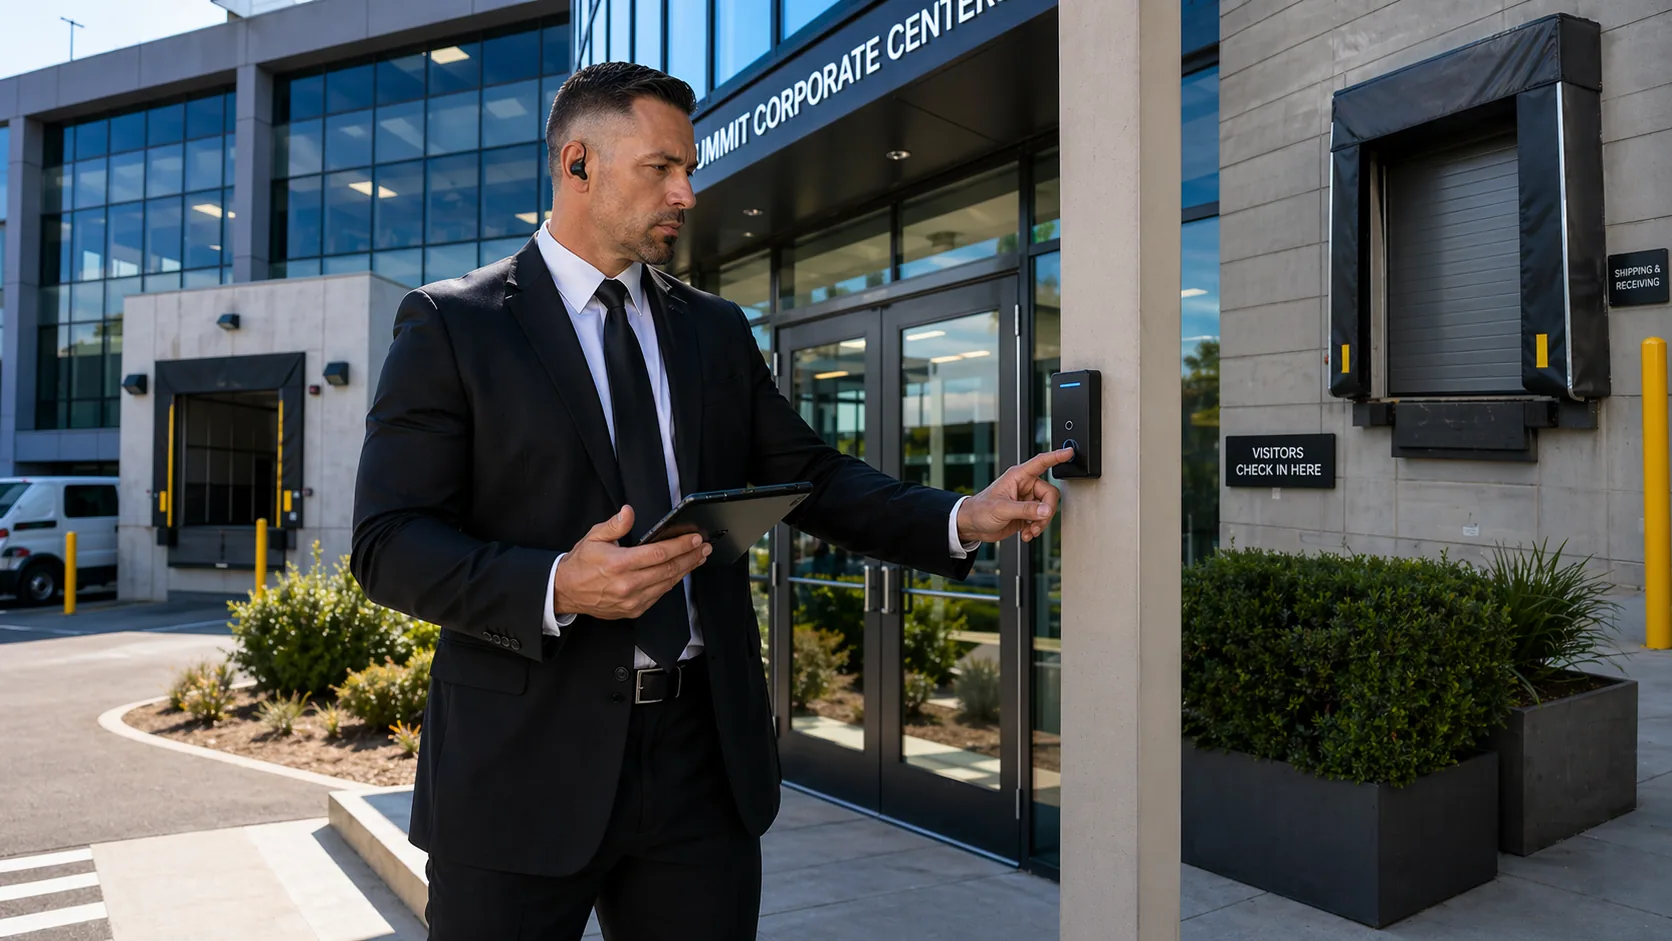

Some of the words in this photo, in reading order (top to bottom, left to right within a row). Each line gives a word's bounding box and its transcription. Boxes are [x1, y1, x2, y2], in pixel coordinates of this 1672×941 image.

[692, 112, 751, 174] UMMIT
[753, 36, 881, 136] CORPORATE
[1614, 265, 1653, 278] SHIPPING
[1654, 264, 1661, 274] &
[1616, 277, 1660, 290] RECEIVING
[1252, 446, 1304, 459] VISITORS
[1235, 463, 1274, 476] CHECK
[1276, 463, 1288, 476] IN
[1290, 463, 1322, 476] HERE
